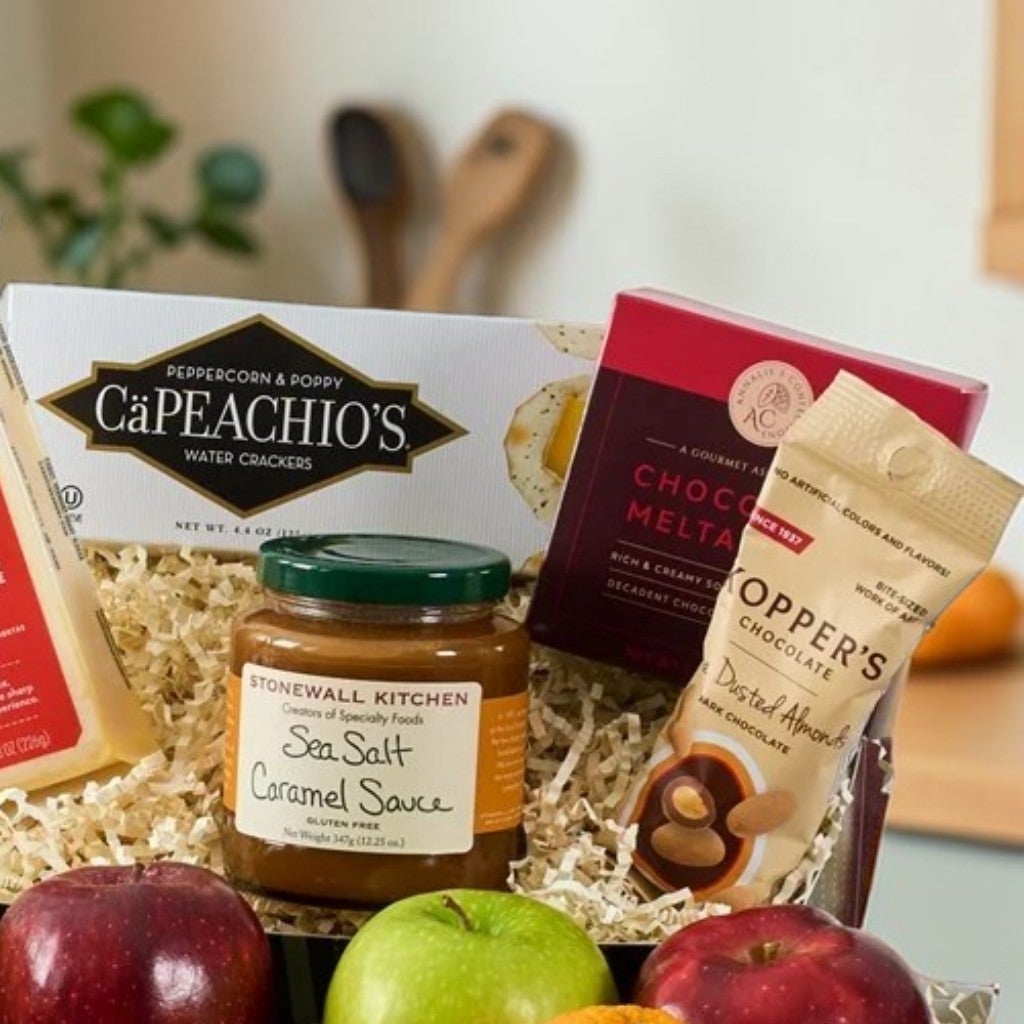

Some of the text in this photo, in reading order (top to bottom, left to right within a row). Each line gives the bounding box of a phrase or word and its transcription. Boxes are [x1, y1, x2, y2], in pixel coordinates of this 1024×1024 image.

[167, 364, 343, 389] PEPPERCORN & POPPY
[184, 449, 312, 471] WATER CRACKERS
[679, 445, 687, 454] A
[691, 449, 748, 472] GOURMET
[175, 521, 200, 532] NET
[256, 527, 272, 537] OZ
[778, 526, 804, 546] 1937
[790, 476, 842, 512] ARTIFICIAL
[842, 507, 881, 537] COLORS
[882, 533, 904, 551] AND
[904, 546, 951, 578] FLAVORS!
[610, 551, 640, 567] RICH
[643, 561, 650, 570] &
[655, 565, 703, 585] CREAMY
[607, 578, 669, 604] DECADENT
[856, 583, 882, 606] WORK
[884, 602, 899, 613] OF
[876, 581, 928, 616] BITE-SIZED
[739, 615, 833, 681] CHOCOLATE
[7, 685, 34, 700] sharp
[250, 675, 469, 707] STONEWALL KITCHEN
[715, 655, 787, 719] Dusted
[780, 702, 851, 750] Almonds
[282, 702, 424, 726] Creators of Specialty Foods
[282, 724, 414, 767] Sea Salt
[725, 711, 791, 755] CHOCOLATE
[251, 761, 349, 813] Caramel
[359, 777, 454, 816] Sauce
[284, 827, 299, 839] Net
[299, 830, 331, 845] Weight
[333, 832, 355, 847] 347g
[306, 816, 381, 830] GLUTEN FREE
